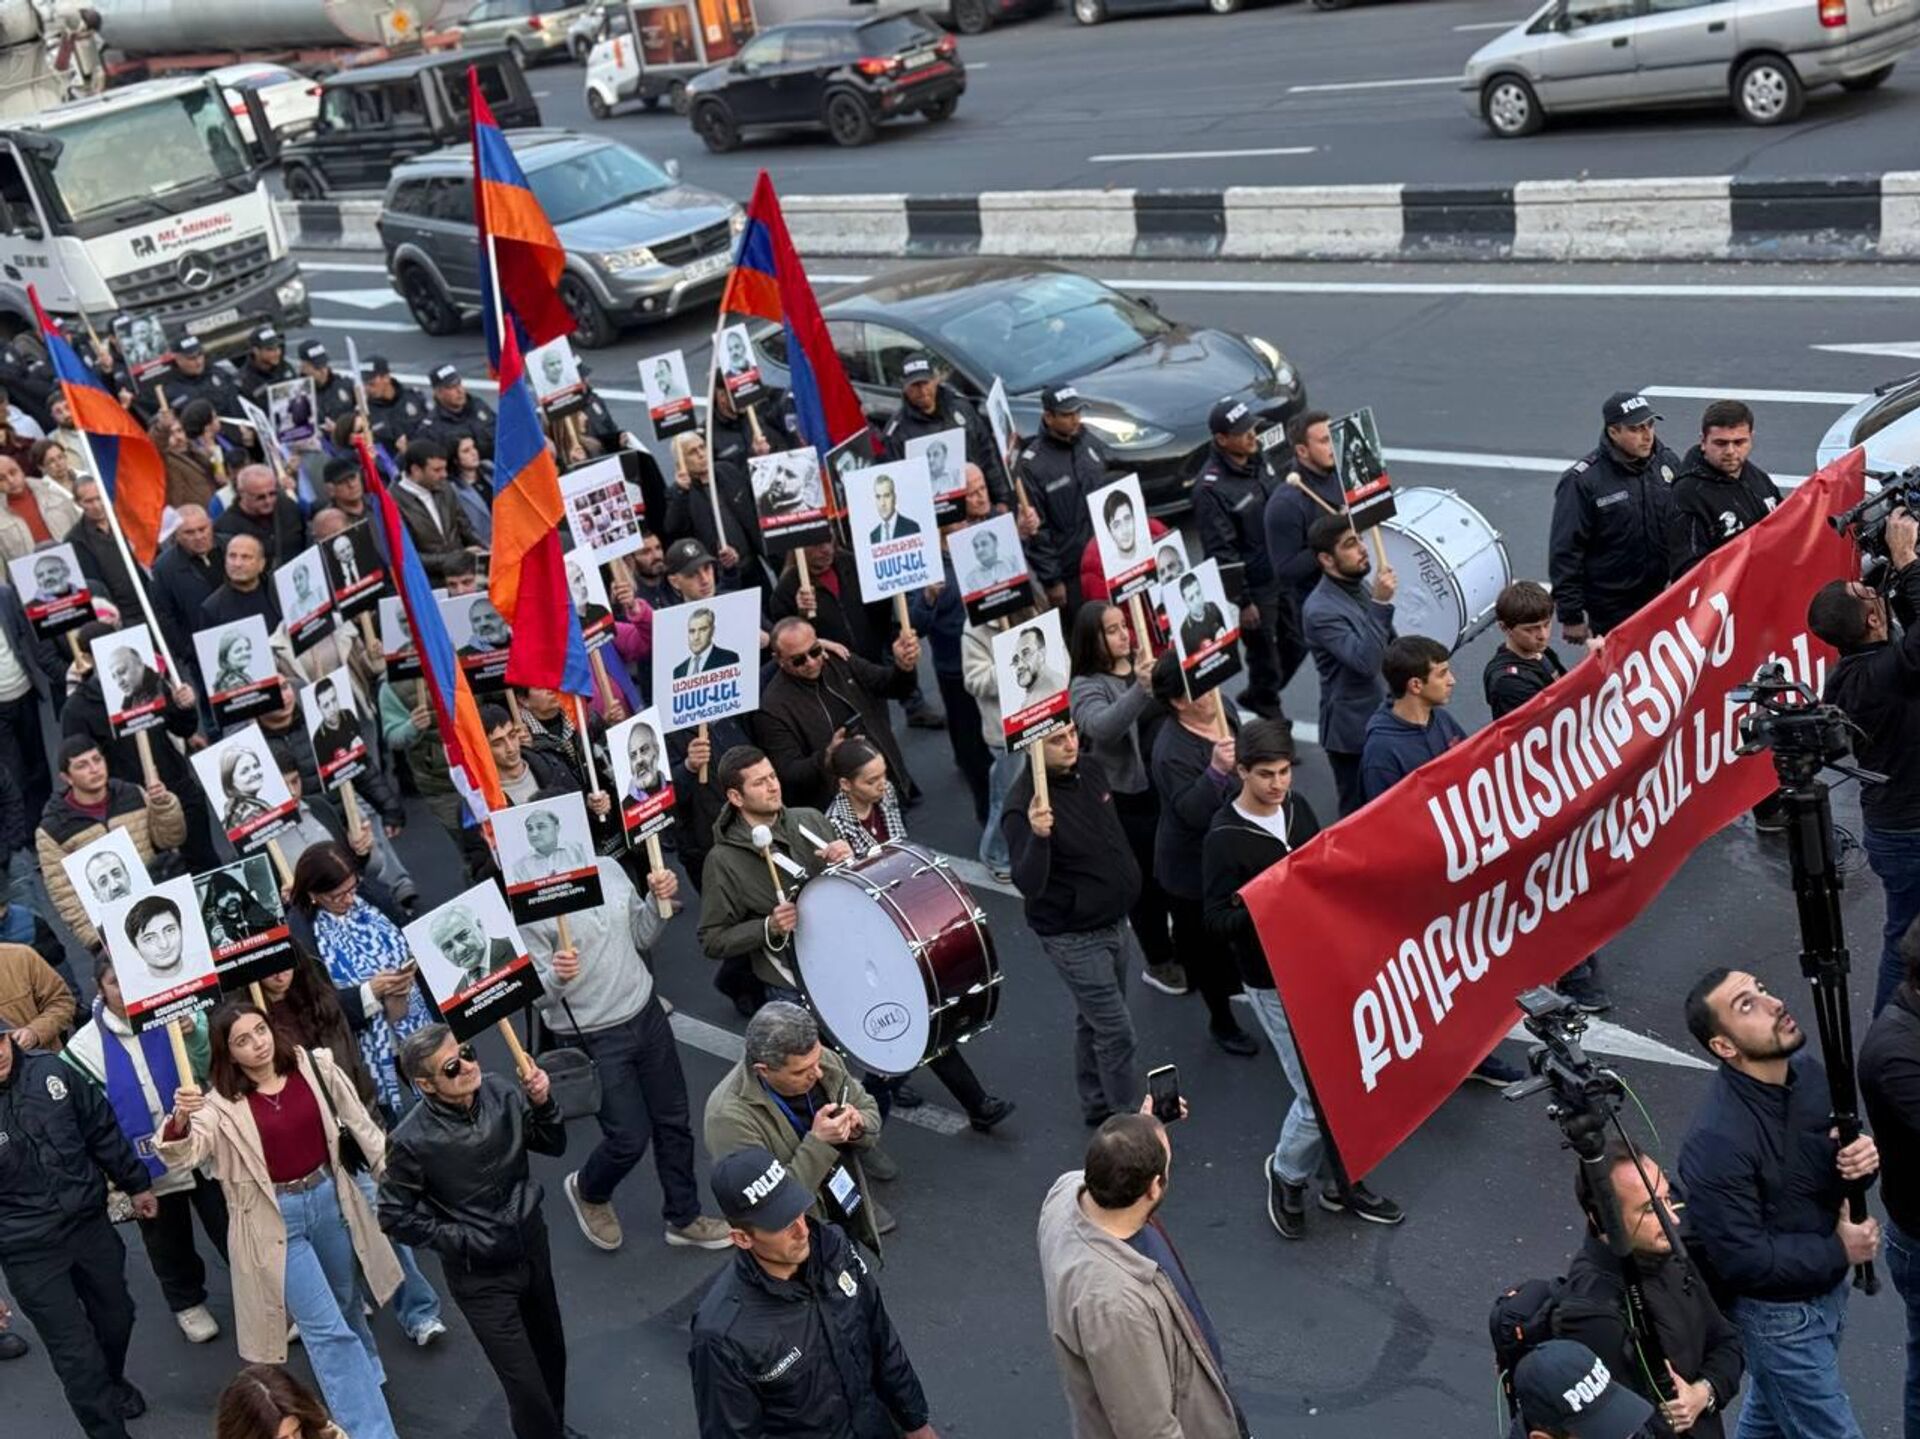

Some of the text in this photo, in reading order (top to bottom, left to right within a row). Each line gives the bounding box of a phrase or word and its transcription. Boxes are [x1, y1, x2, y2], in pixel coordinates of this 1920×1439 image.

[182, 213, 232, 234] MINING
[874, 550, 927, 580] ՍԱՄՎԵԼ
[672, 680, 741, 713] ՍԱՄՎԵԼ
